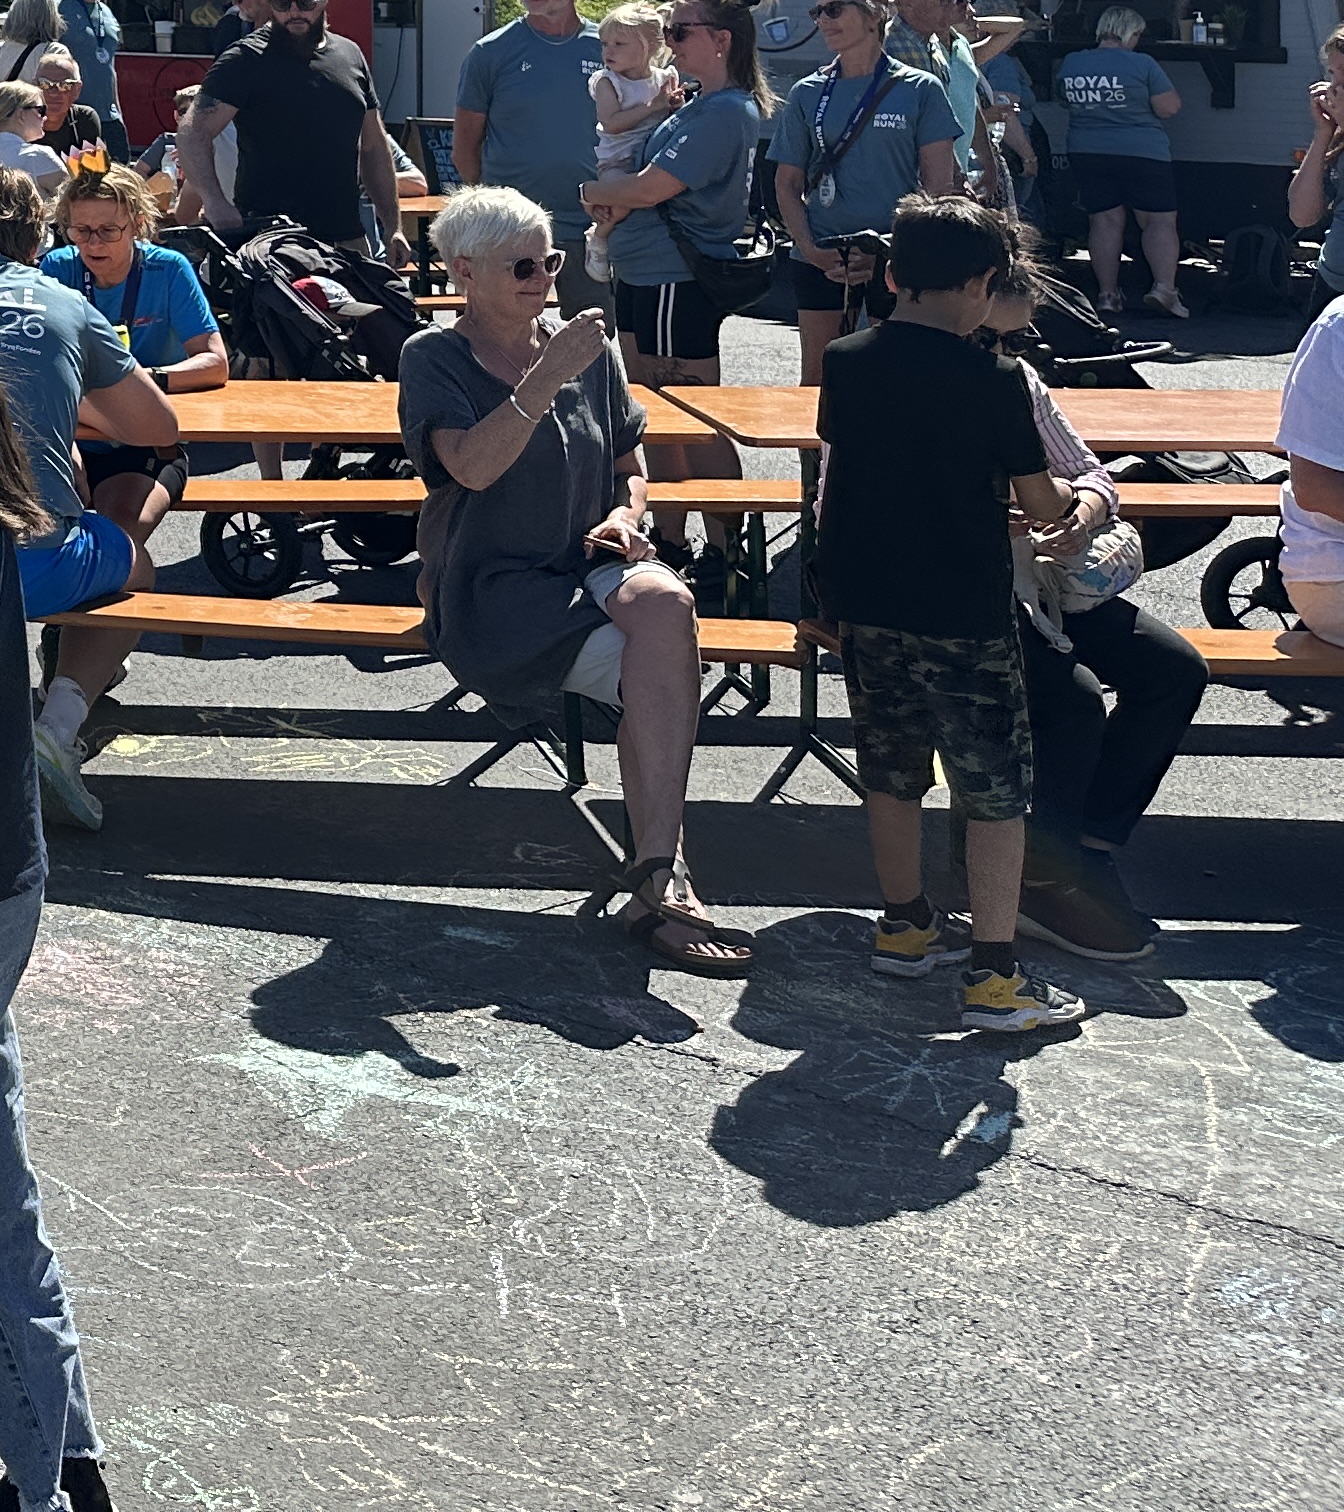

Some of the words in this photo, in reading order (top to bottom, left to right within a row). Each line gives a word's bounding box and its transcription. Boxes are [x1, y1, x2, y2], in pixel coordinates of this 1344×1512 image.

[581, 59, 606, 69] ROYA
[1063, 75, 1124, 90] ROYAL
[1065, 90, 1102, 103] RUN
[874, 113, 907, 122] ROYAL
[873, 120, 896, 128] RUN
